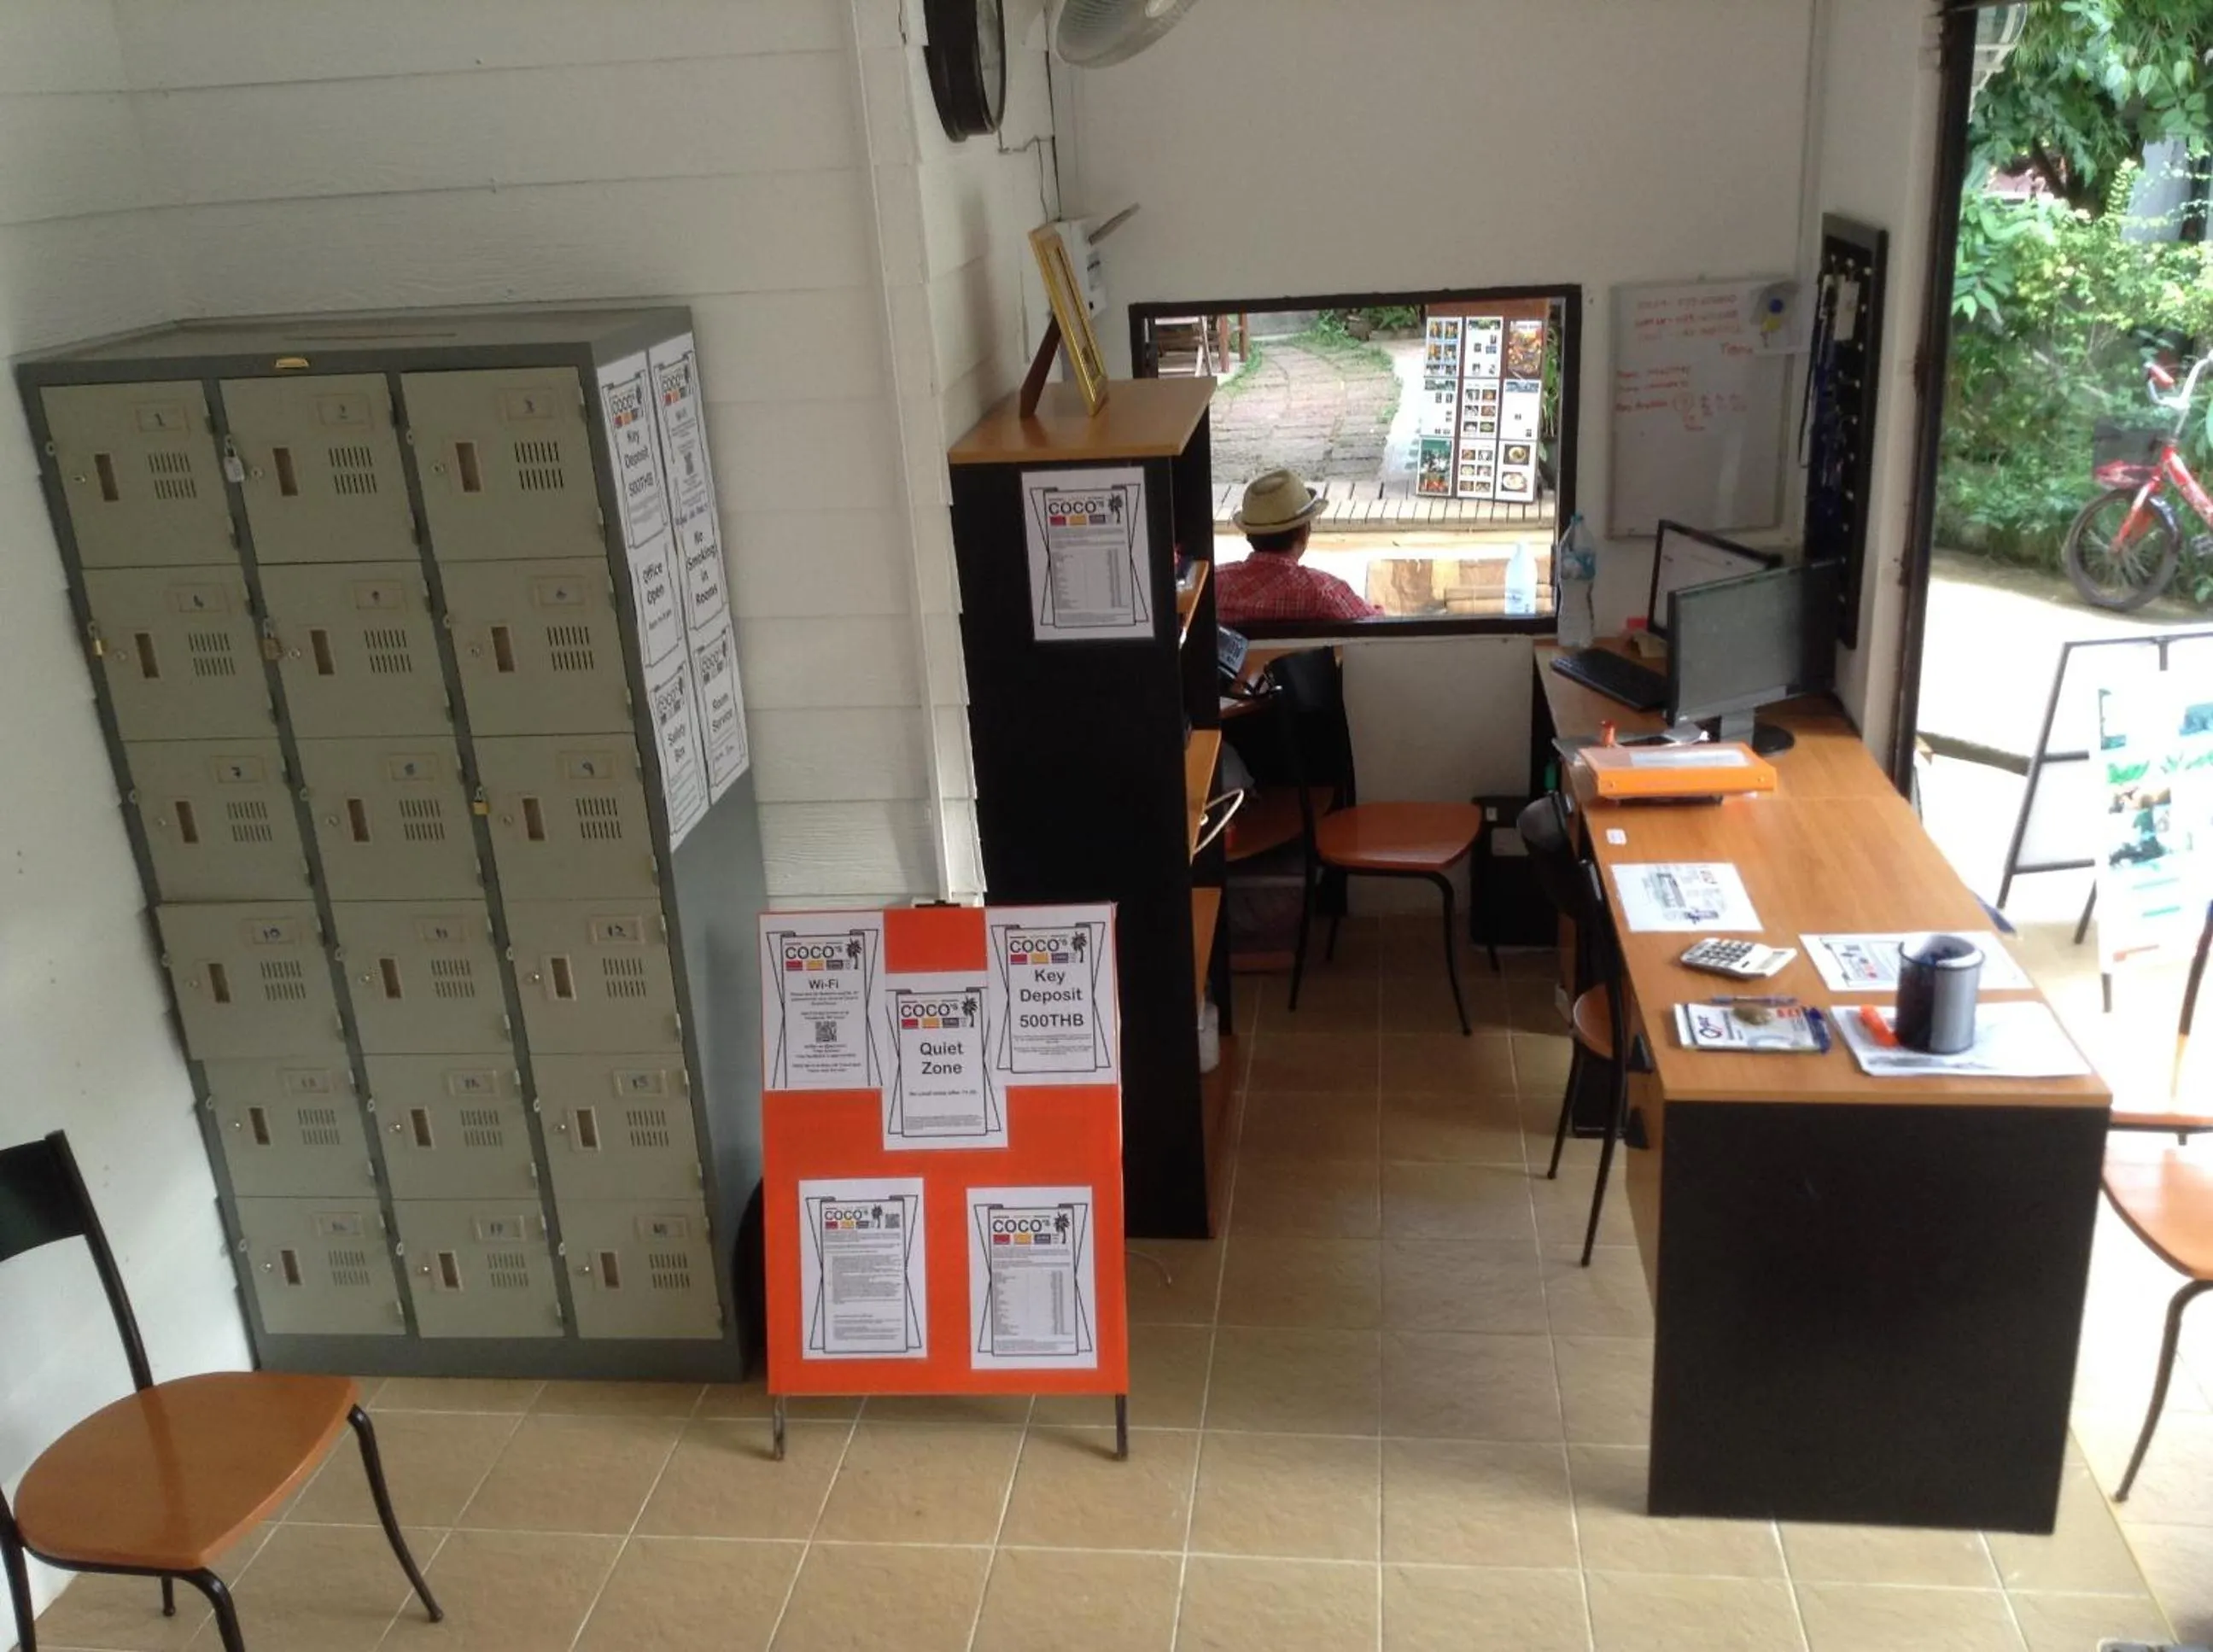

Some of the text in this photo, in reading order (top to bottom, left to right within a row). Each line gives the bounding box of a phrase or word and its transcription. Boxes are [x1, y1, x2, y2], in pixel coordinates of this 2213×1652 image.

[809, 979, 839, 989] Wi-Fi
[1034, 969, 1066, 985] Key
[1020, 989, 1083, 1004] Deposit
[1020, 1013, 1084, 1028] 500THB
[920, 1042, 964, 1056] Quiet
[921, 1061, 963, 1075] Zone
